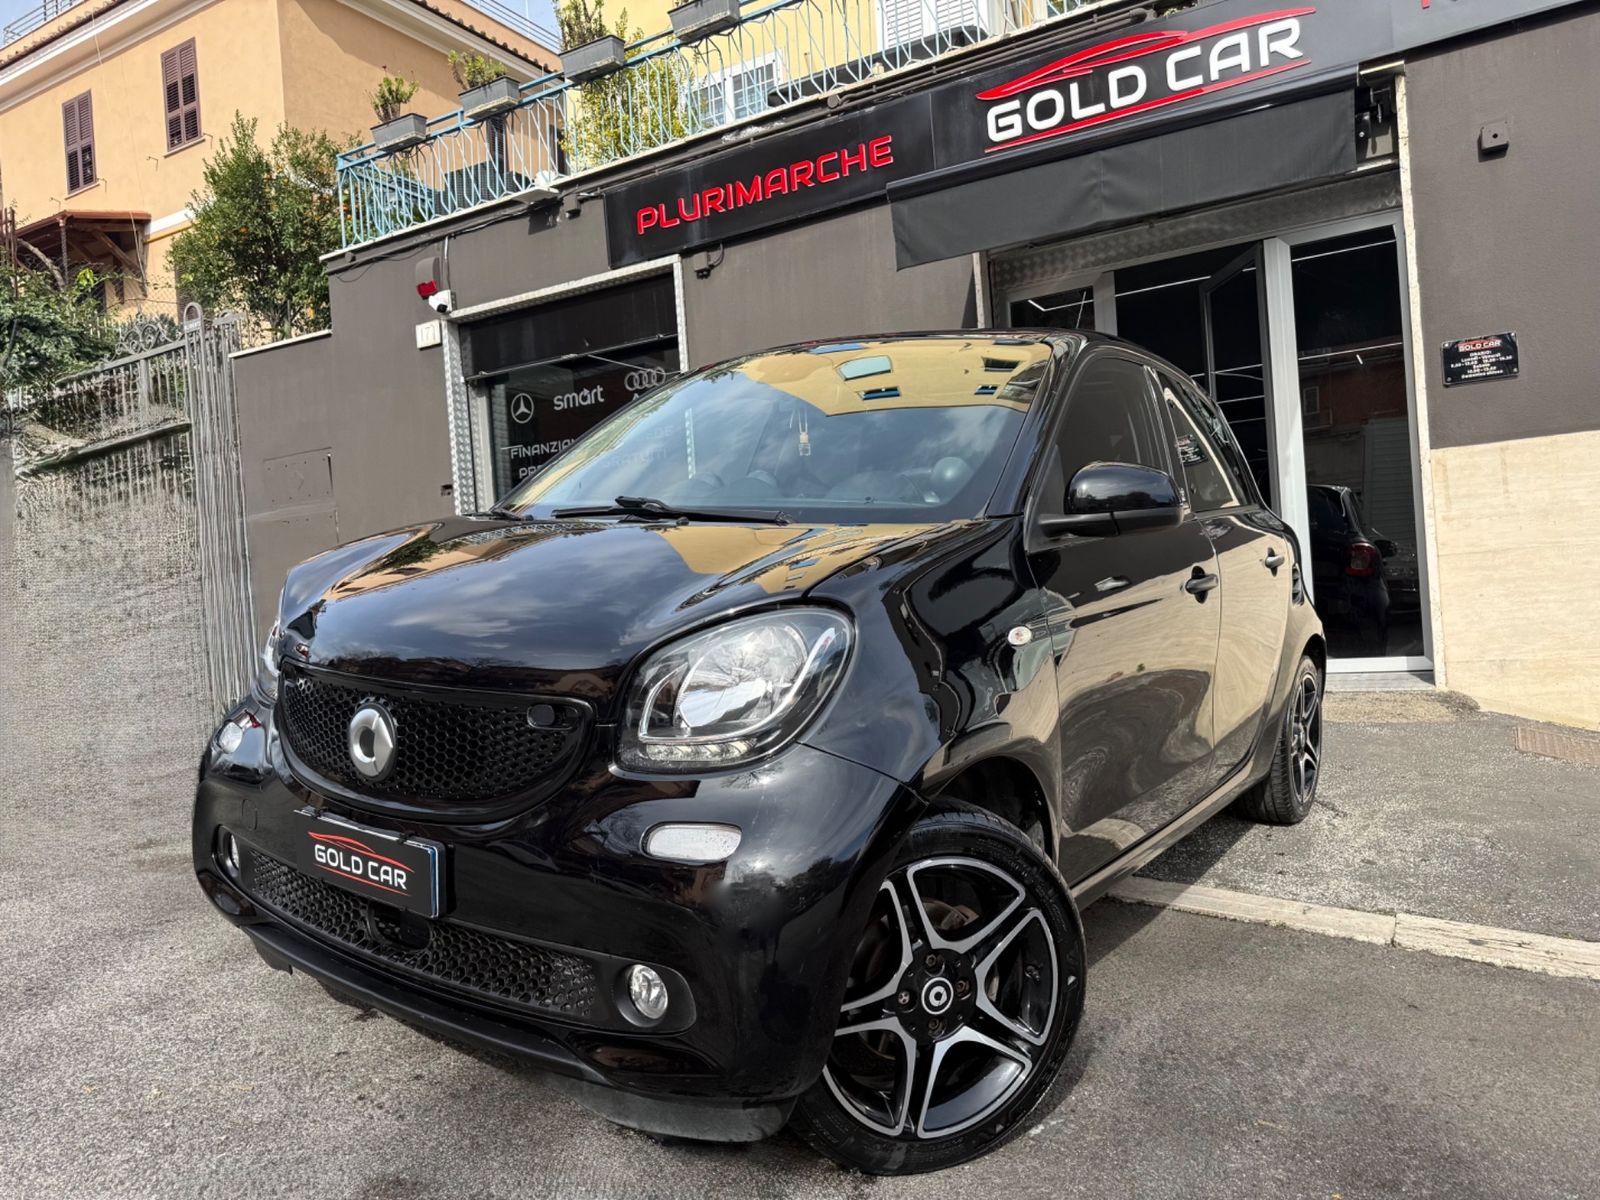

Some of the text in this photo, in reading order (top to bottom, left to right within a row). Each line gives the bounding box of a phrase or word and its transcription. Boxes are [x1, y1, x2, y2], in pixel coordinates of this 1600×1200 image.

[985, 17, 1305, 144] GOLD CAR
[636, 134, 894, 236] PLURIMARCHE
[553, 384, 605, 411] smart
[314, 844, 408, 890] GOLD CAR
